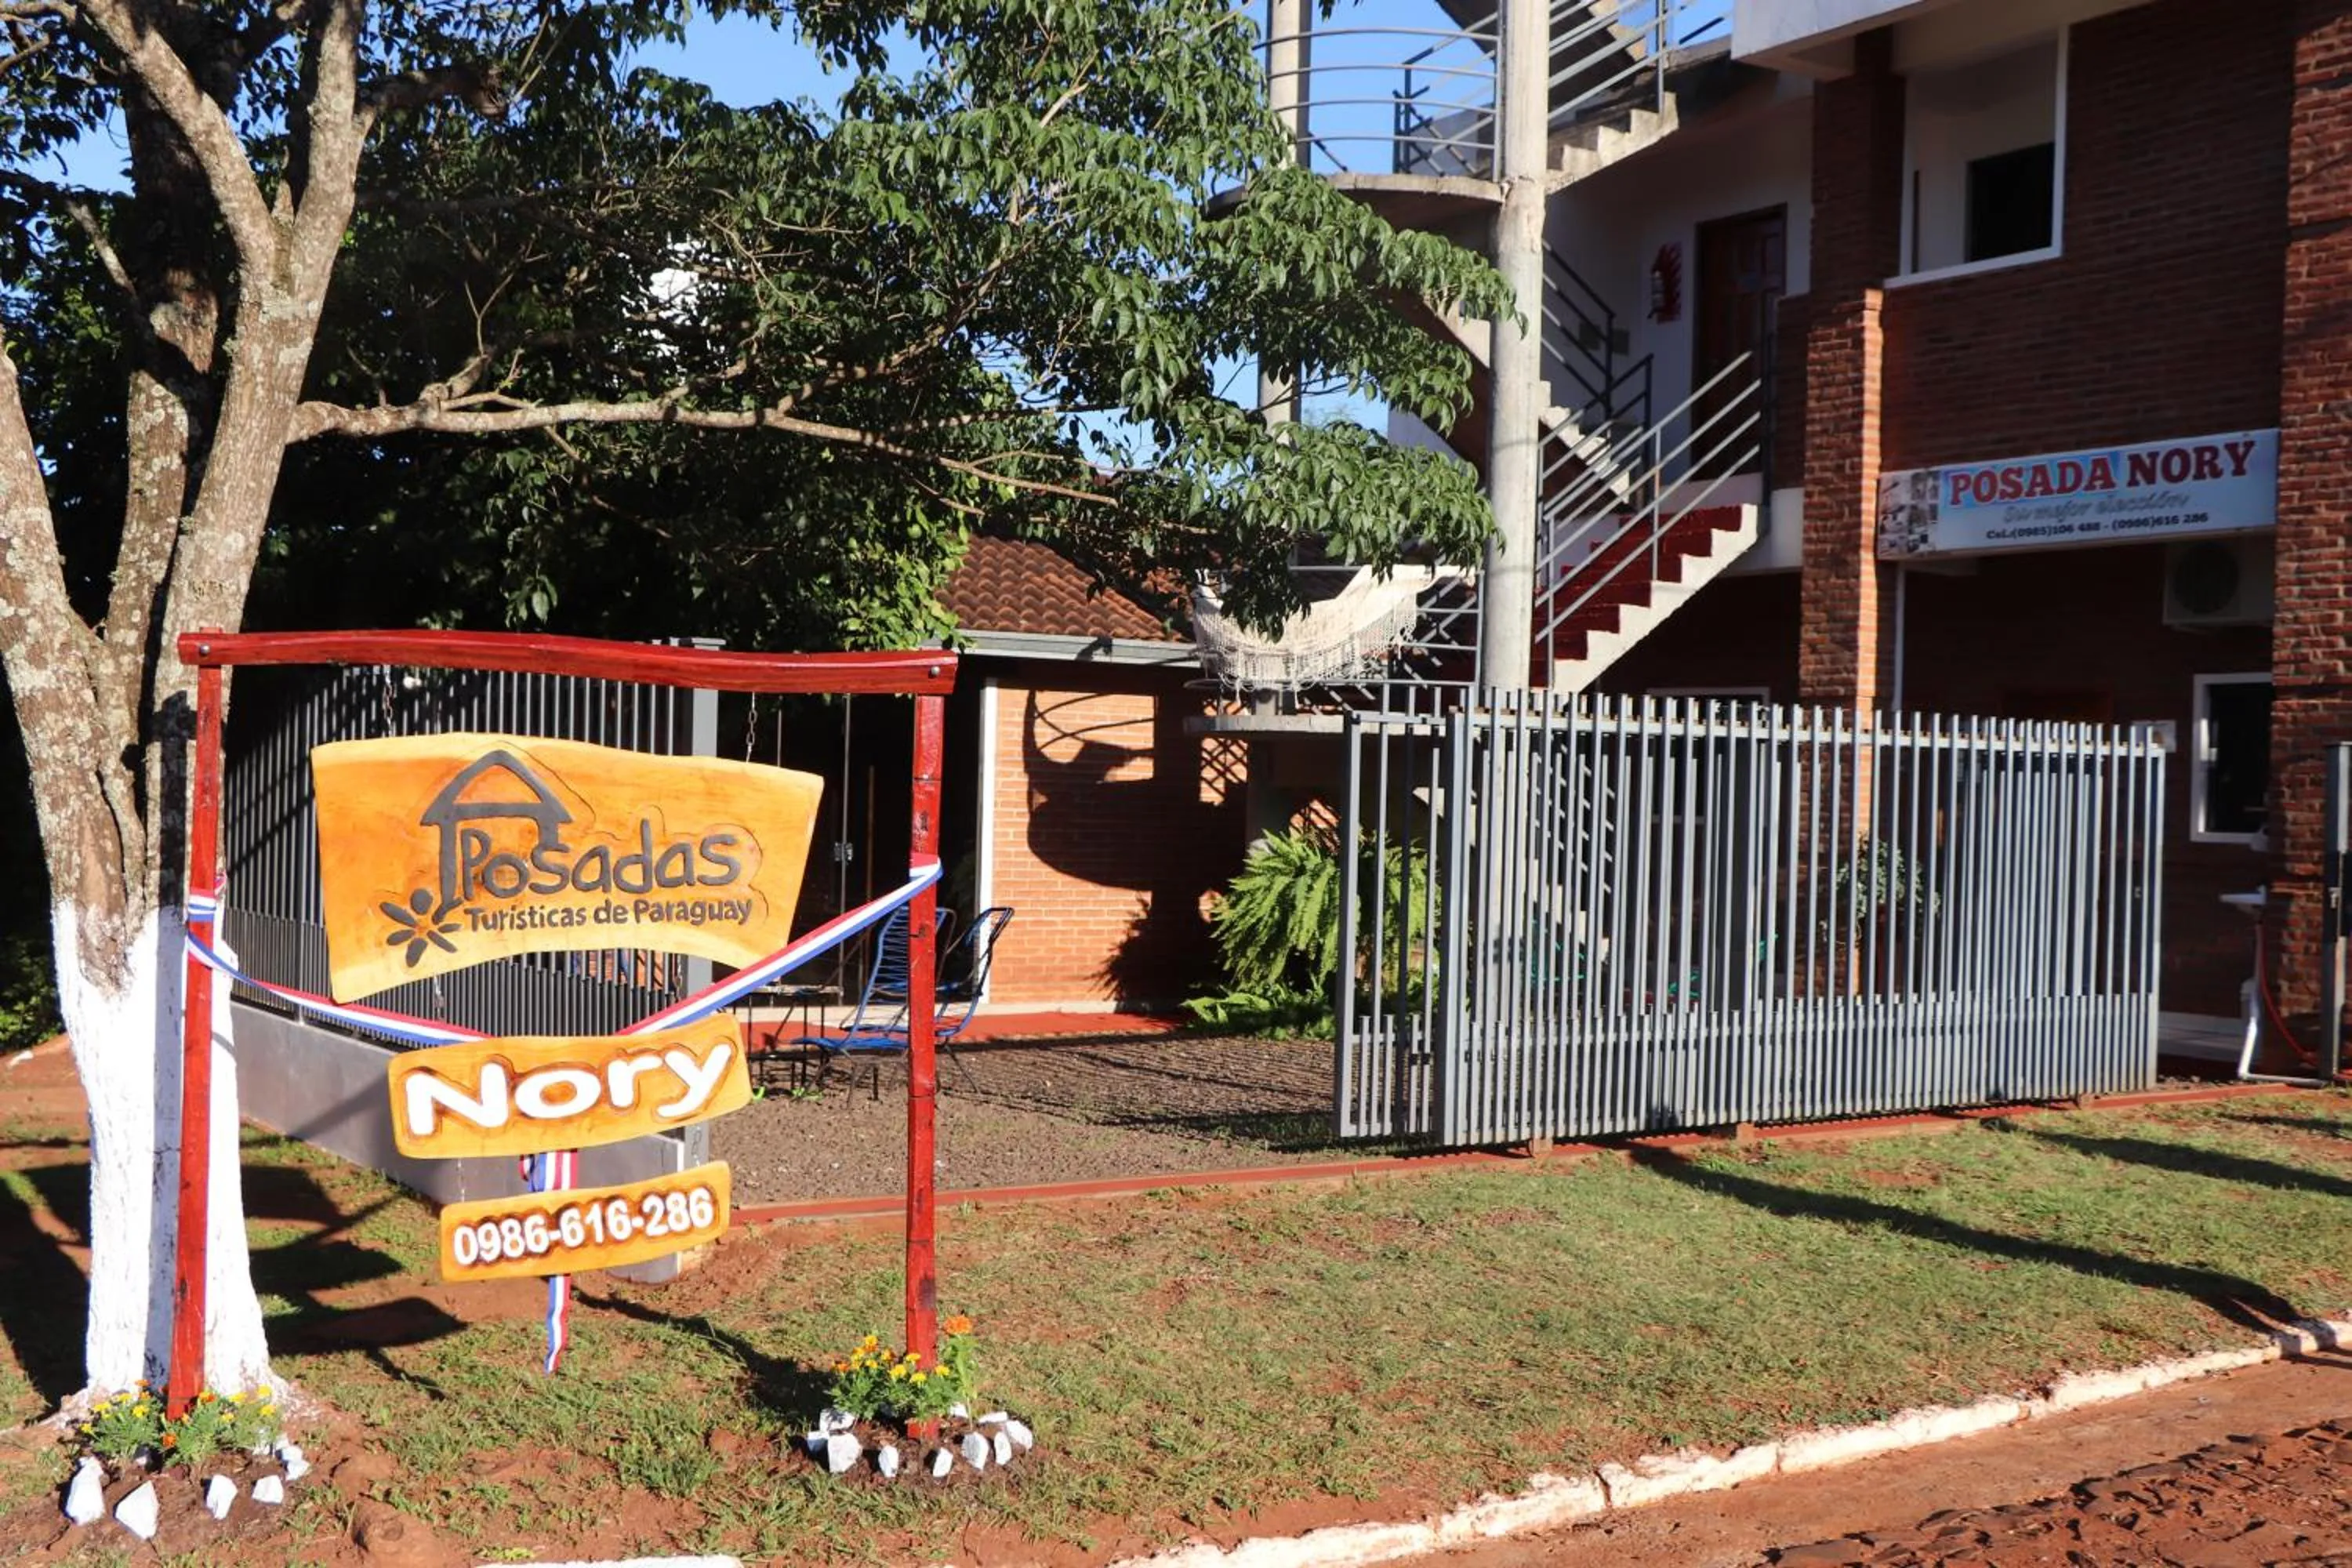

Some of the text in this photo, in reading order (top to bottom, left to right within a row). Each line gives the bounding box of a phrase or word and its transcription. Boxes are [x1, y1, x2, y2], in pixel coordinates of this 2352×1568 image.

[1949, 440, 2256, 506] POSADA NORY
[460, 818, 741, 901] Posadas
[593, 899, 628, 924] de
[633, 898, 753, 926] Paraguay
[405, 1044, 734, 1136] Nory
[453, 1186, 715, 1267] 0986-616-286
